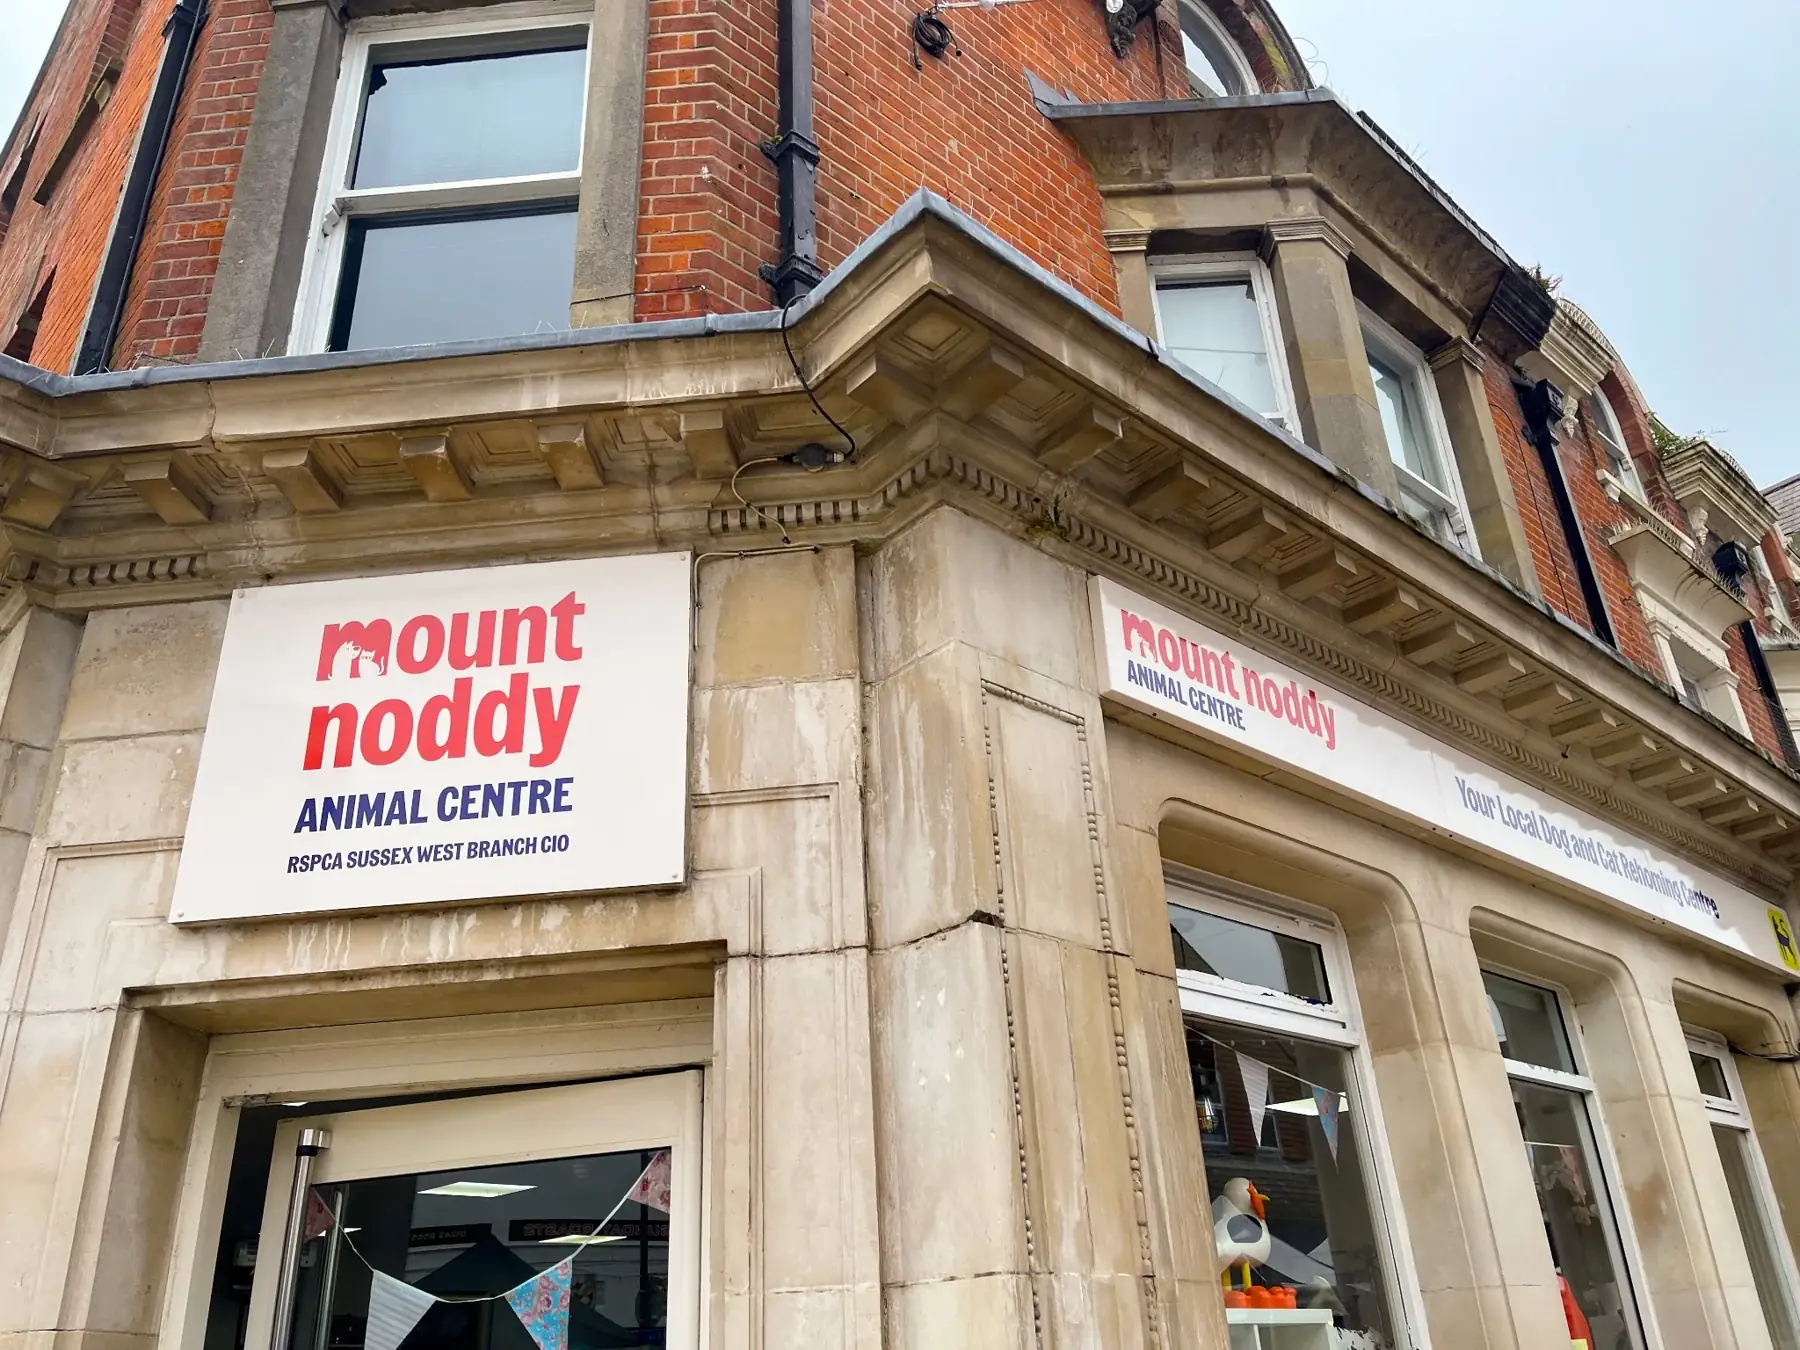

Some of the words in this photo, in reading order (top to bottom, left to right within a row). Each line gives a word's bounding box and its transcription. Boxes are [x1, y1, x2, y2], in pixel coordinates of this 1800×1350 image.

[316, 591, 585, 682] mount
[1120, 609, 1240, 700] mount
[1242, 666, 1336, 750] noddy
[303, 671, 581, 771] noddy
[1127, 660, 1188, 706] ANIMAL
[1189, 686, 1246, 731] CENTRE
[293, 789, 428, 834] ANIMAL
[437, 777, 574, 822] CENTRE
[1454, 775, 1496, 820] Your
[1496, 795, 1542, 840] Local
[1539, 814, 1572, 859] Dog
[1570, 834, 1600, 867] and
[1597, 841, 1623, 876] Cat
[1619, 851, 1684, 907] Rehoming
[1680, 880, 1720, 919] Centre
[287, 852, 343, 874] RSPCA
[346, 846, 414, 869] SUSSEX
[417, 842, 465, 863] WEST
[468, 837, 538, 860] BRANCH
[541, 834, 570, 853] CIO
